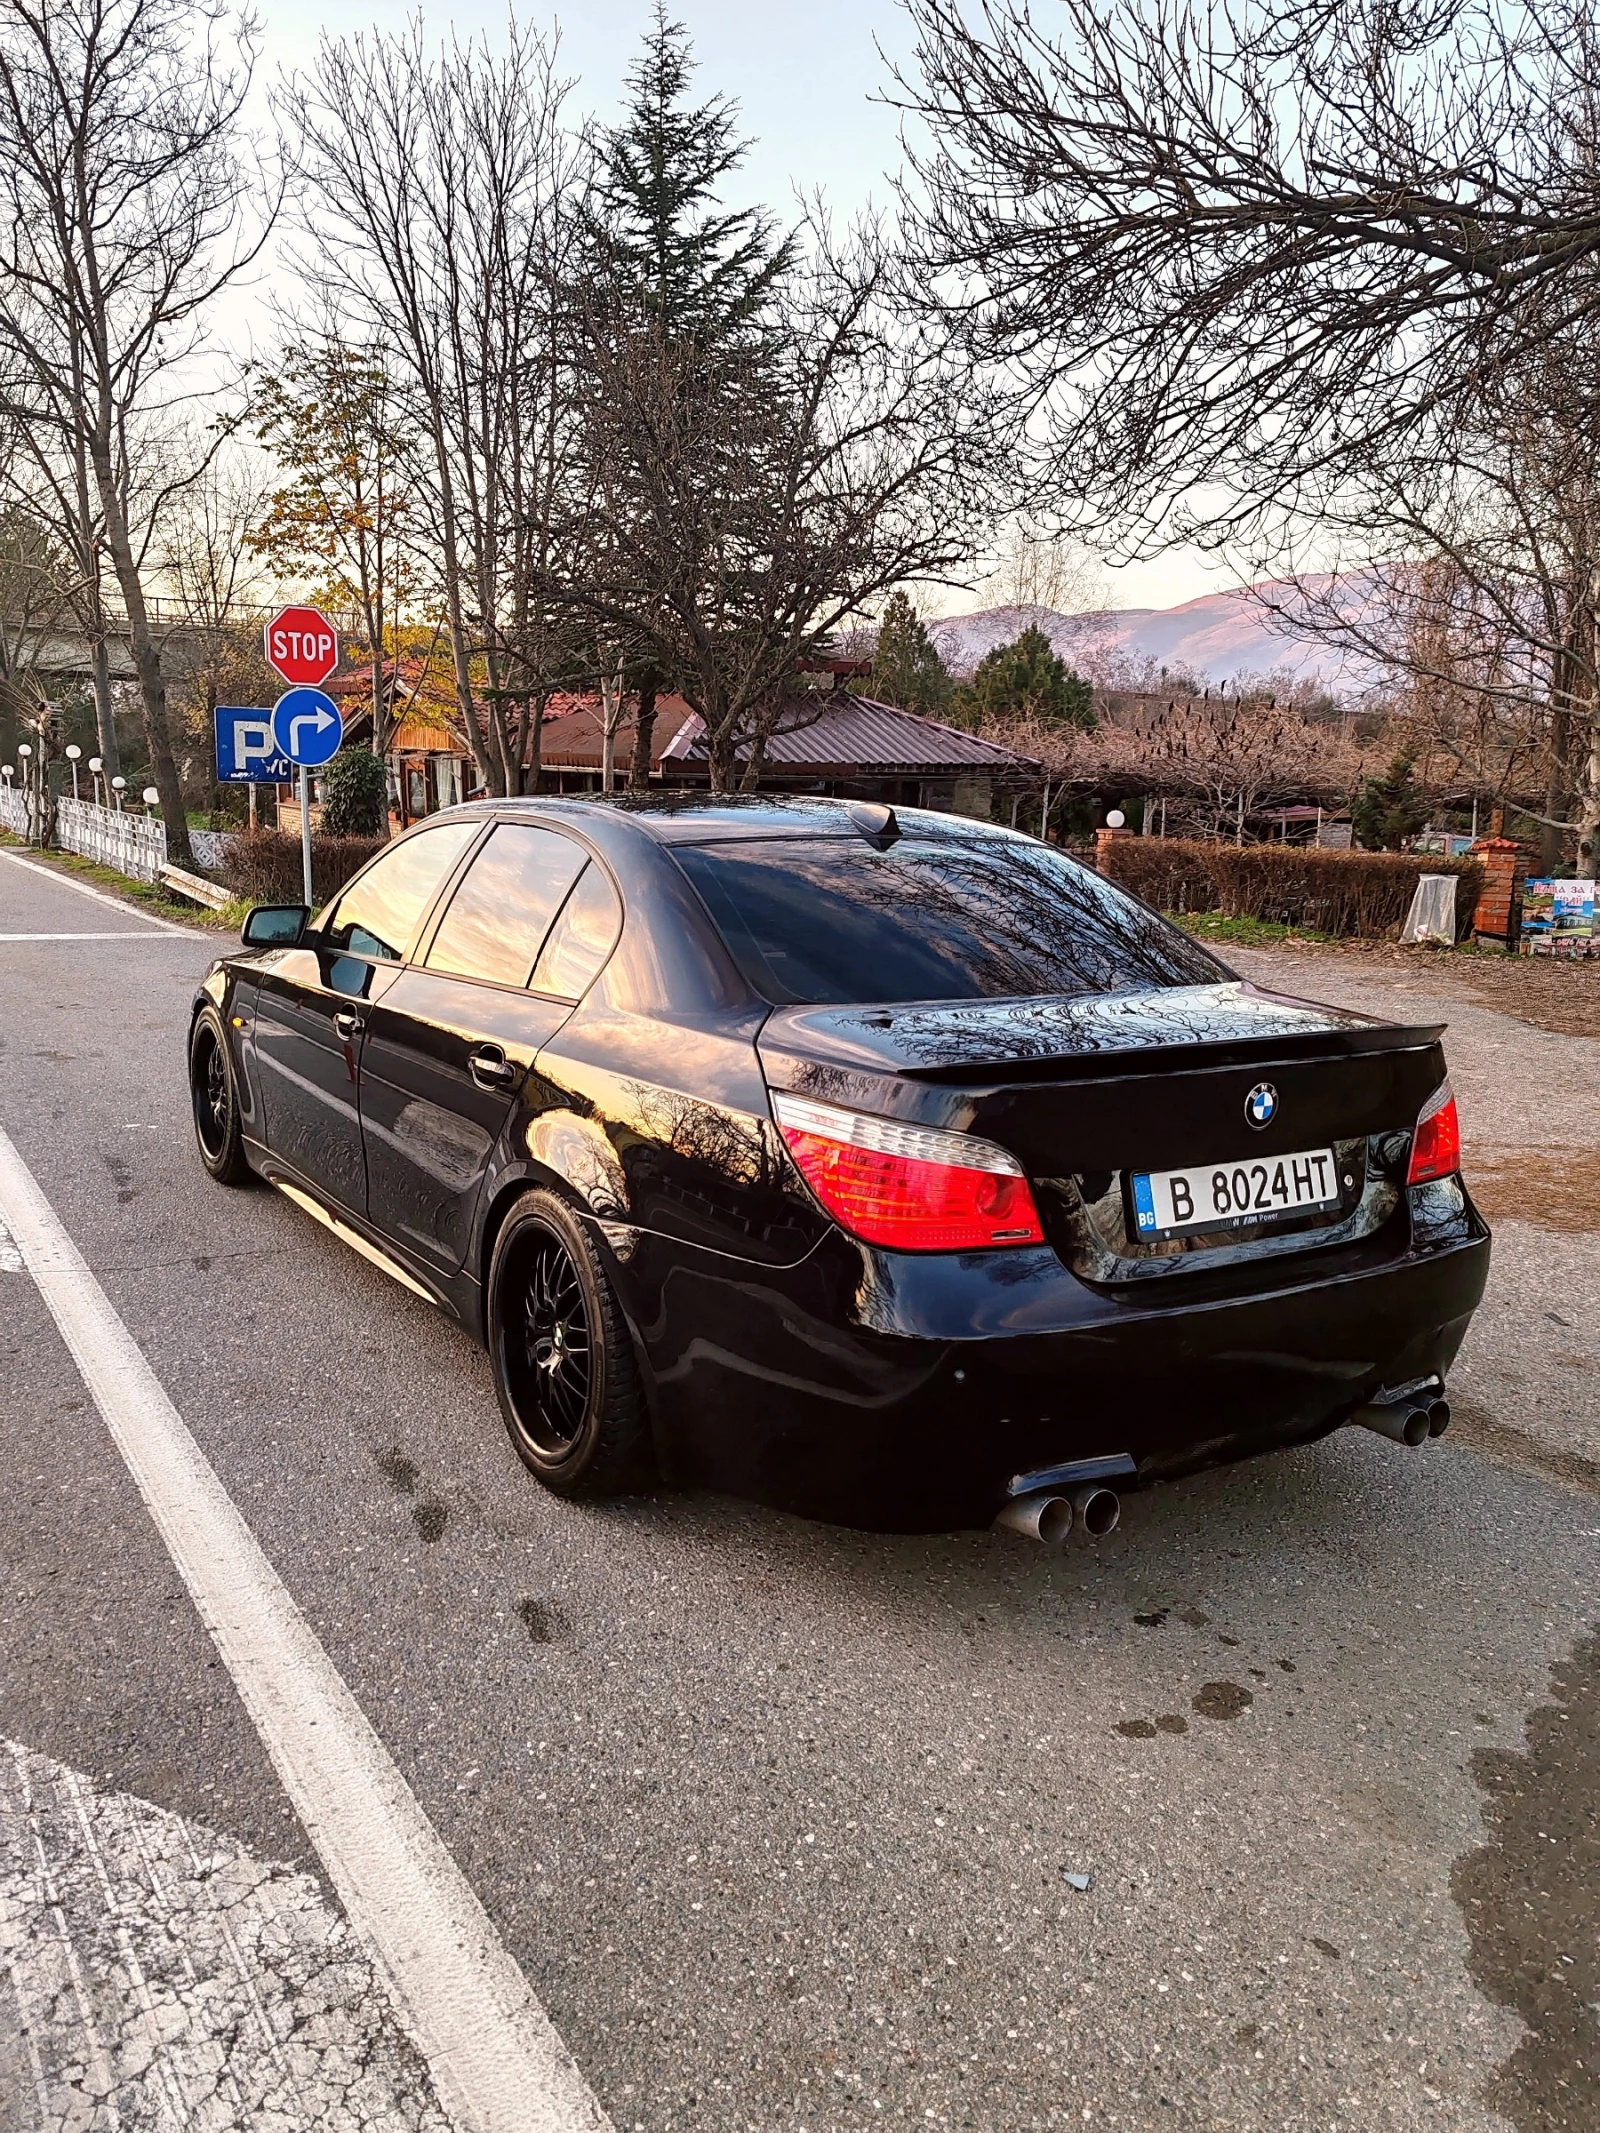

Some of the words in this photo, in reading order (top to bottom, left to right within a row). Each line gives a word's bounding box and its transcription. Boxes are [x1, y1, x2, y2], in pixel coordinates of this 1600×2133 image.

[273, 630, 332, 662] STOP
[233, 720, 275, 770] P
[1249, 1084, 1278, 1100] BMW
[1169, 1176, 1195, 1222] B
[1138, 1211, 1155, 1227] BG
[1259, 1212, 1279, 1222] Power
